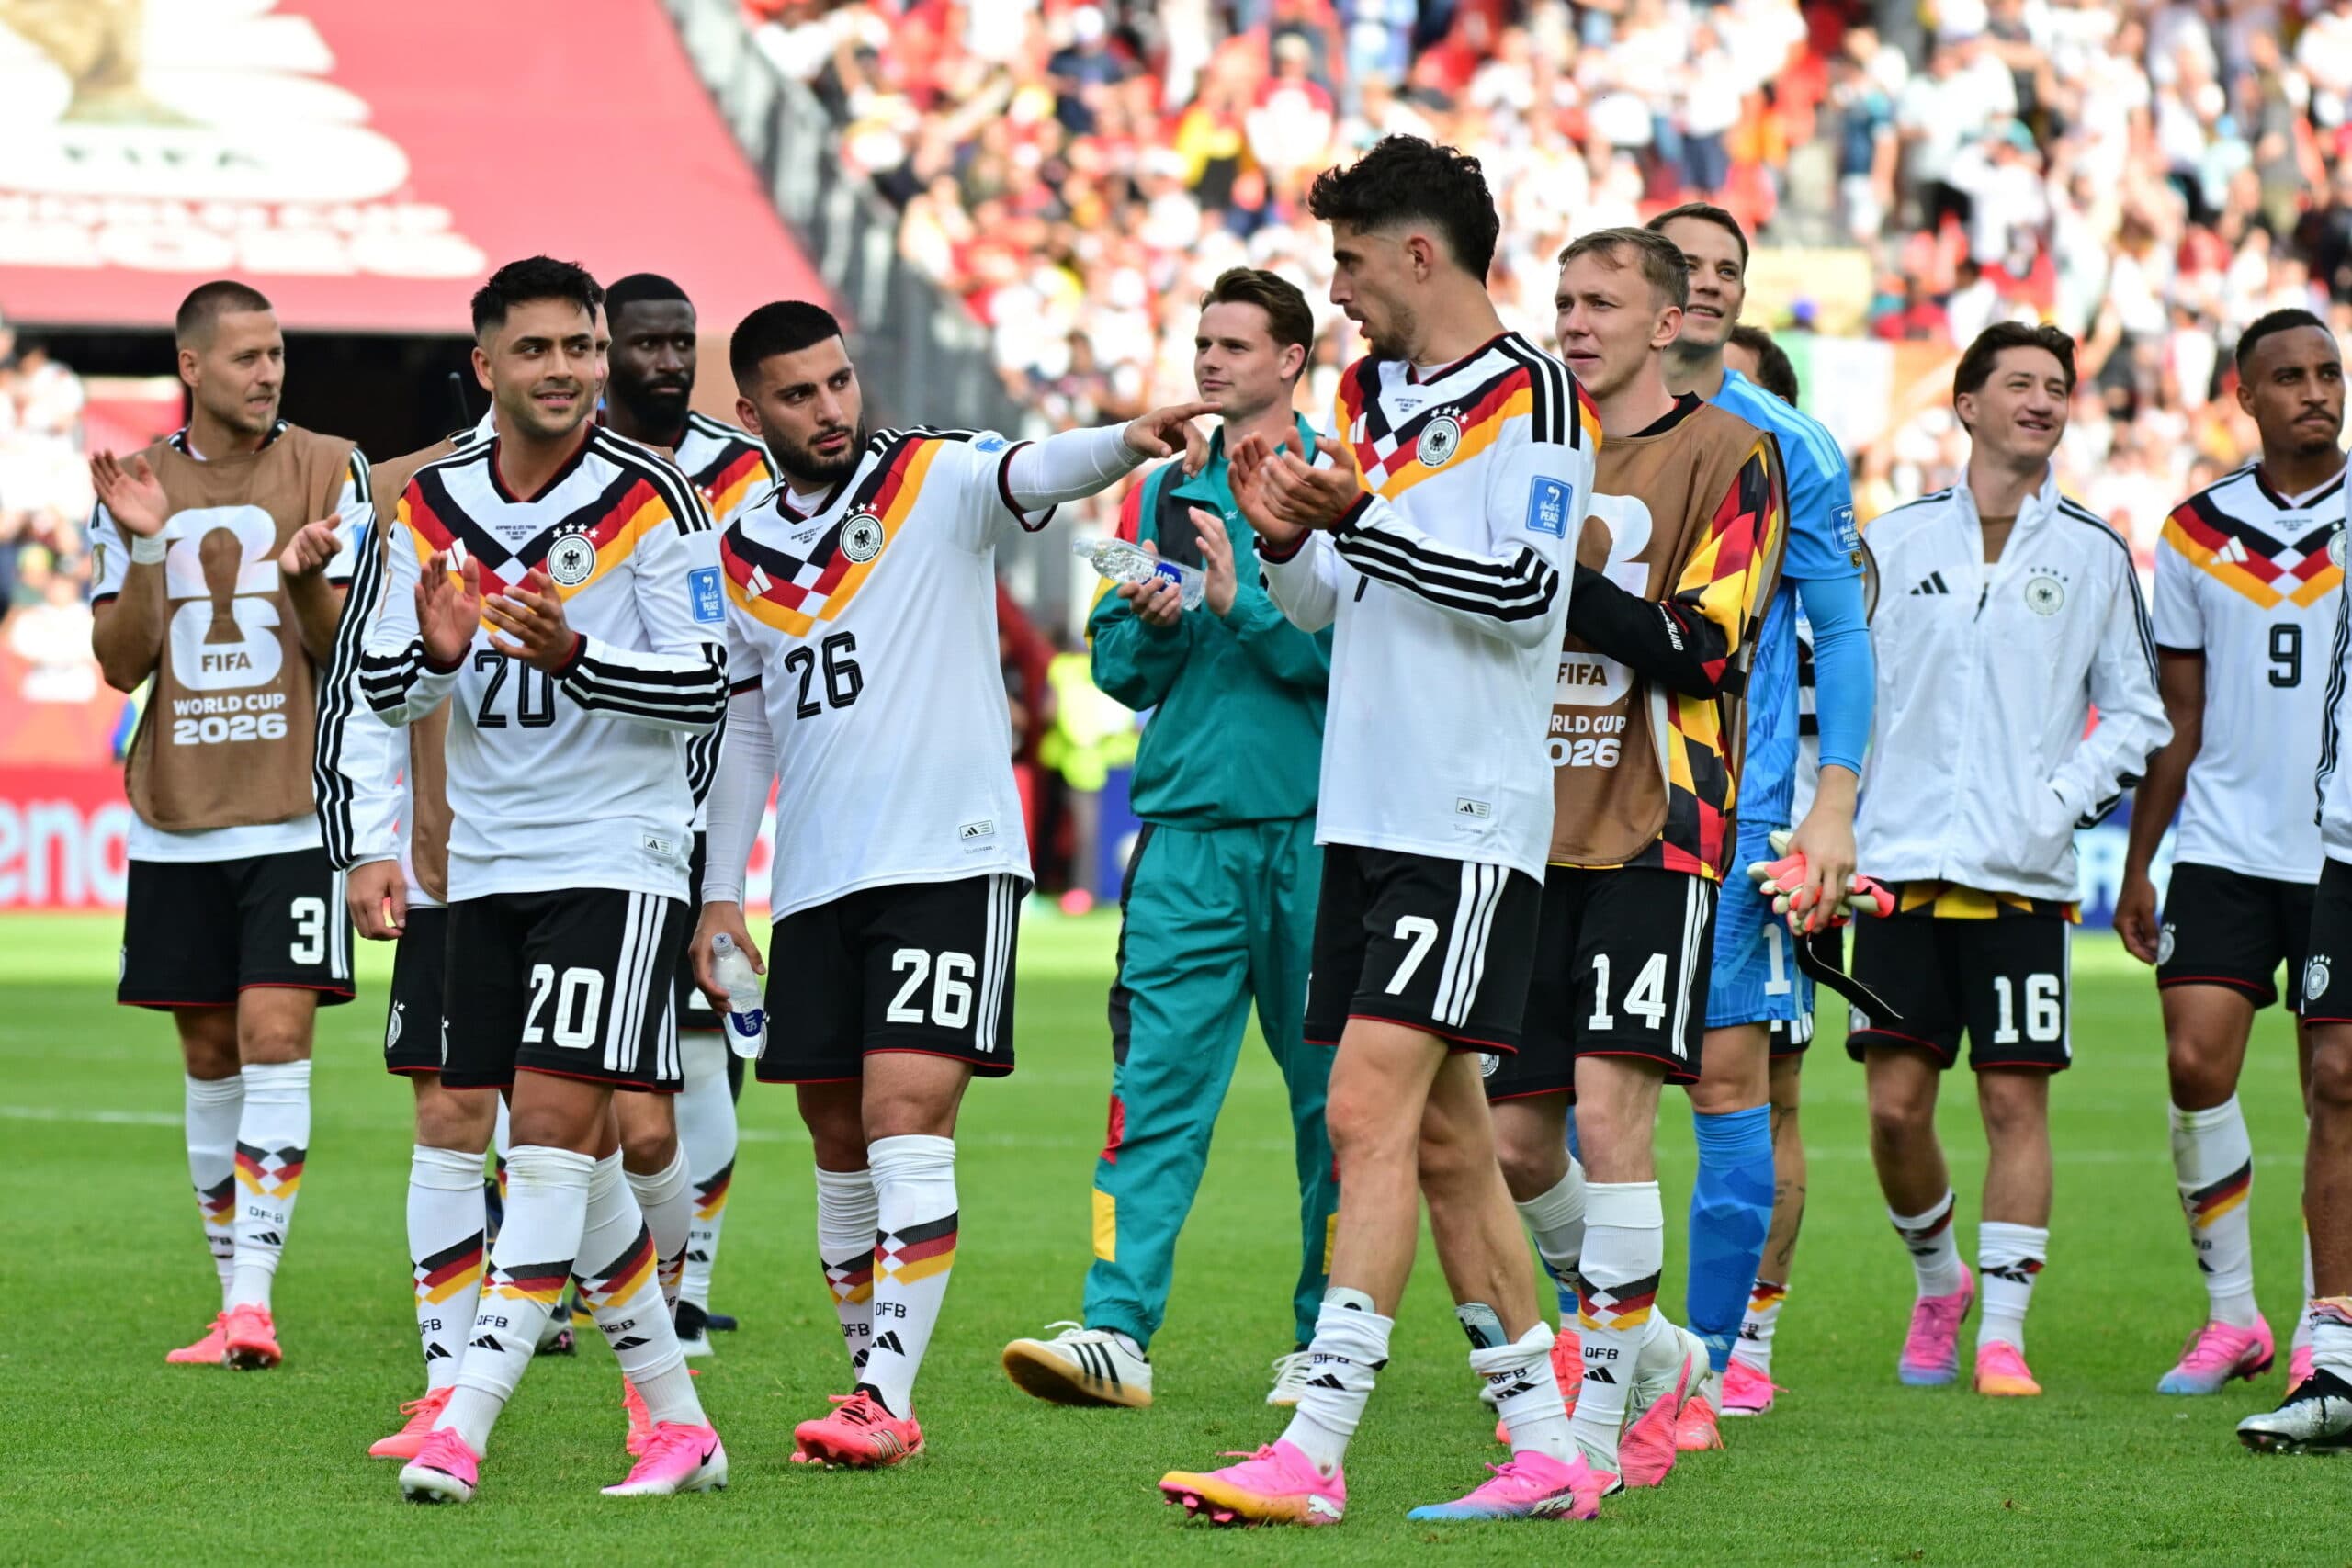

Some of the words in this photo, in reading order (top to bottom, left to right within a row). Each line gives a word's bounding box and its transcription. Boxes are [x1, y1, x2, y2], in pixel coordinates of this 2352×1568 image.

[201, 652, 252, 672] FIFA
[2268, 623, 2302, 688] 9
[474, 649, 556, 728] 20
[784, 630, 864, 720] 26
[1556, 662, 1608, 686] FIFA
[173, 695, 242, 716] WORLD
[245, 694, 286, 712] CUP
[173, 713, 288, 745] 2026
[1551, 714, 1590, 733] RLD
[1592, 715, 1626, 733] CUP
[1546, 737, 1622, 768] 026
[290, 897, 325, 964] 3
[1385, 915, 1439, 995] 7
[1763, 922, 1792, 996] 1
[886, 948, 976, 1029] 26
[1589, 953, 1668, 1030] 14
[522, 964, 605, 1049] 20
[1993, 973, 2061, 1043] 16
[249, 1205, 284, 1224] DFB
[690, 1231, 712, 1240] FB
[876, 1302, 907, 1318] DFB
[842, 1323, 871, 1337] DFB
[1585, 1346, 1619, 1359] DFB
[1489, 1367, 1528, 1384] DFB
